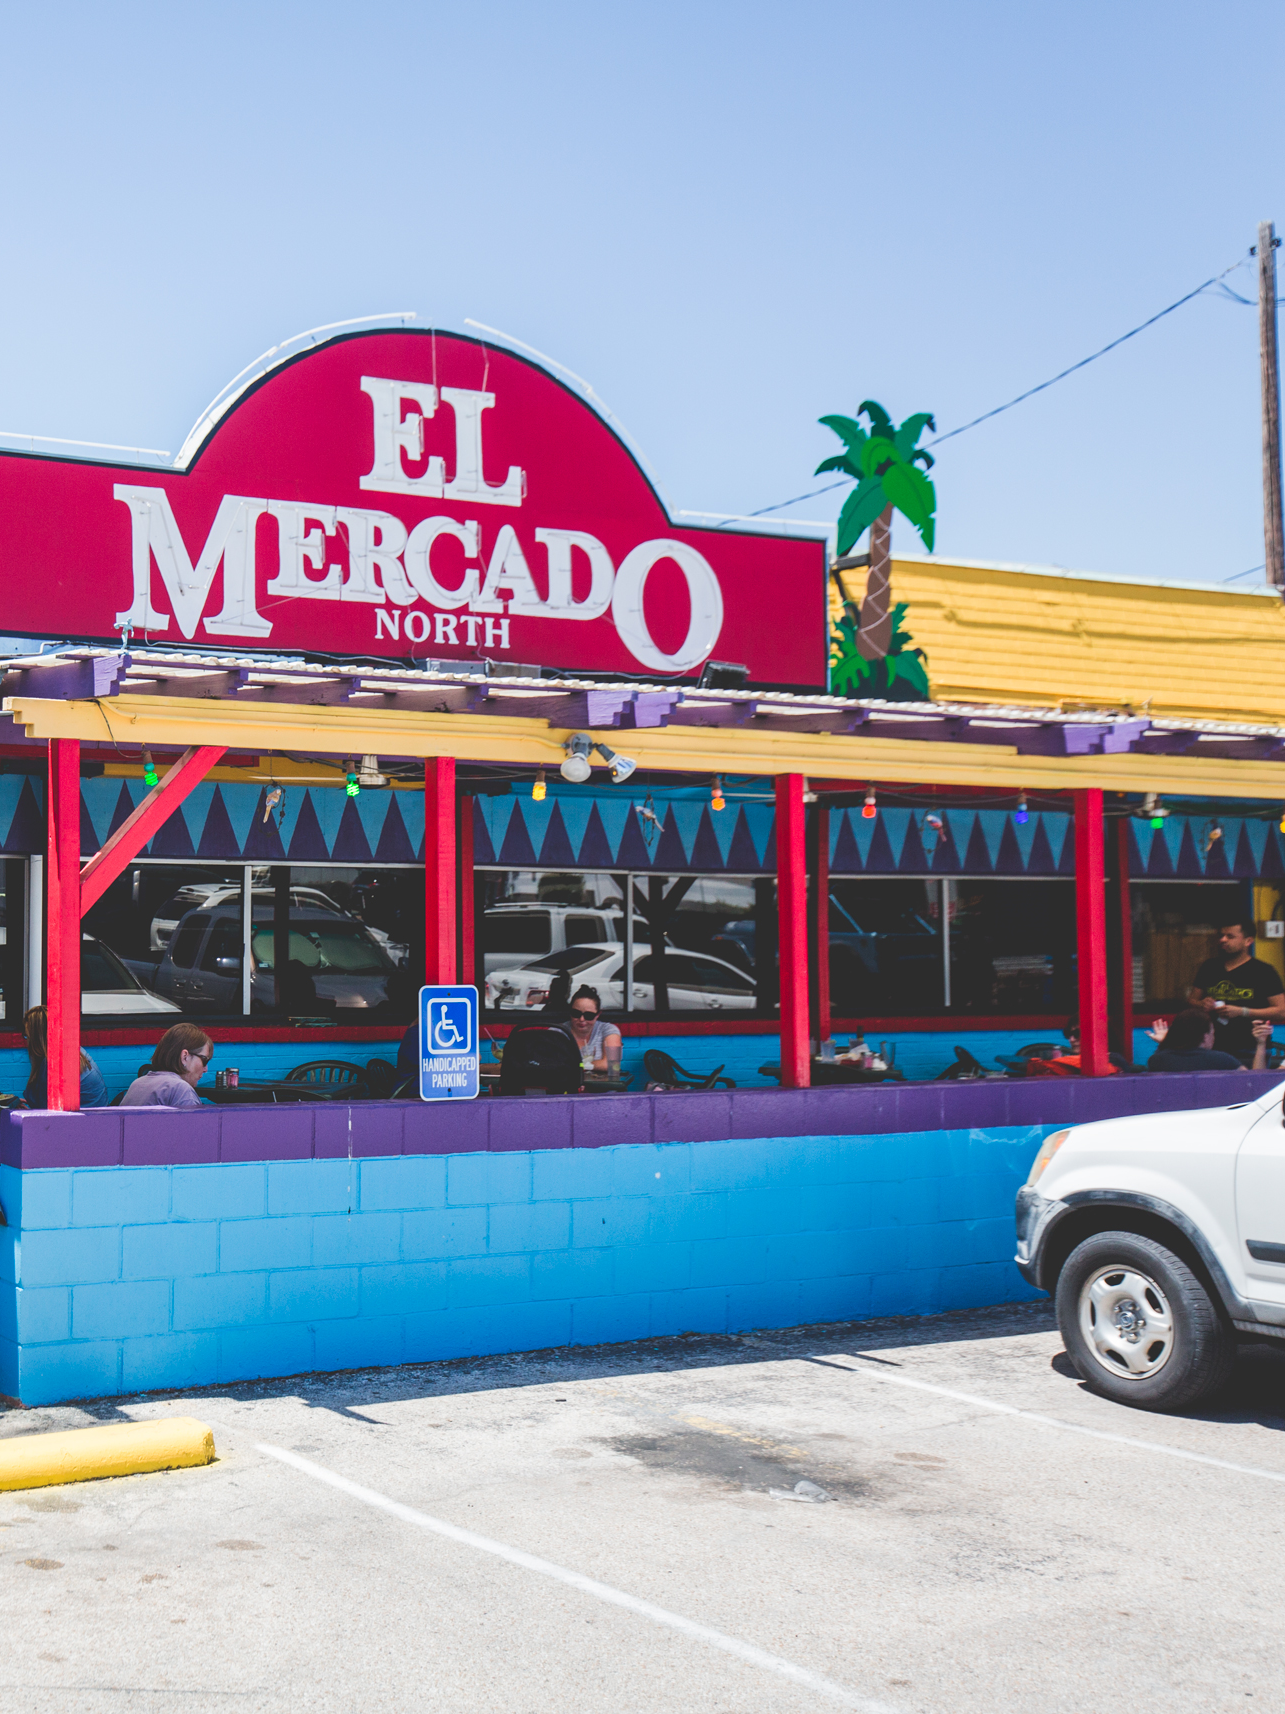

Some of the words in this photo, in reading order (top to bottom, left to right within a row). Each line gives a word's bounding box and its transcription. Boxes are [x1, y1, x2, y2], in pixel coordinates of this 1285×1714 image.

[359, 375, 522, 506] EL
[114, 483, 723, 672] MERCADO
[374, 608, 511, 649] NORTH
[423, 1057, 476, 1073] HANDICAPPED
[432, 1073, 468, 1088] PARKING
